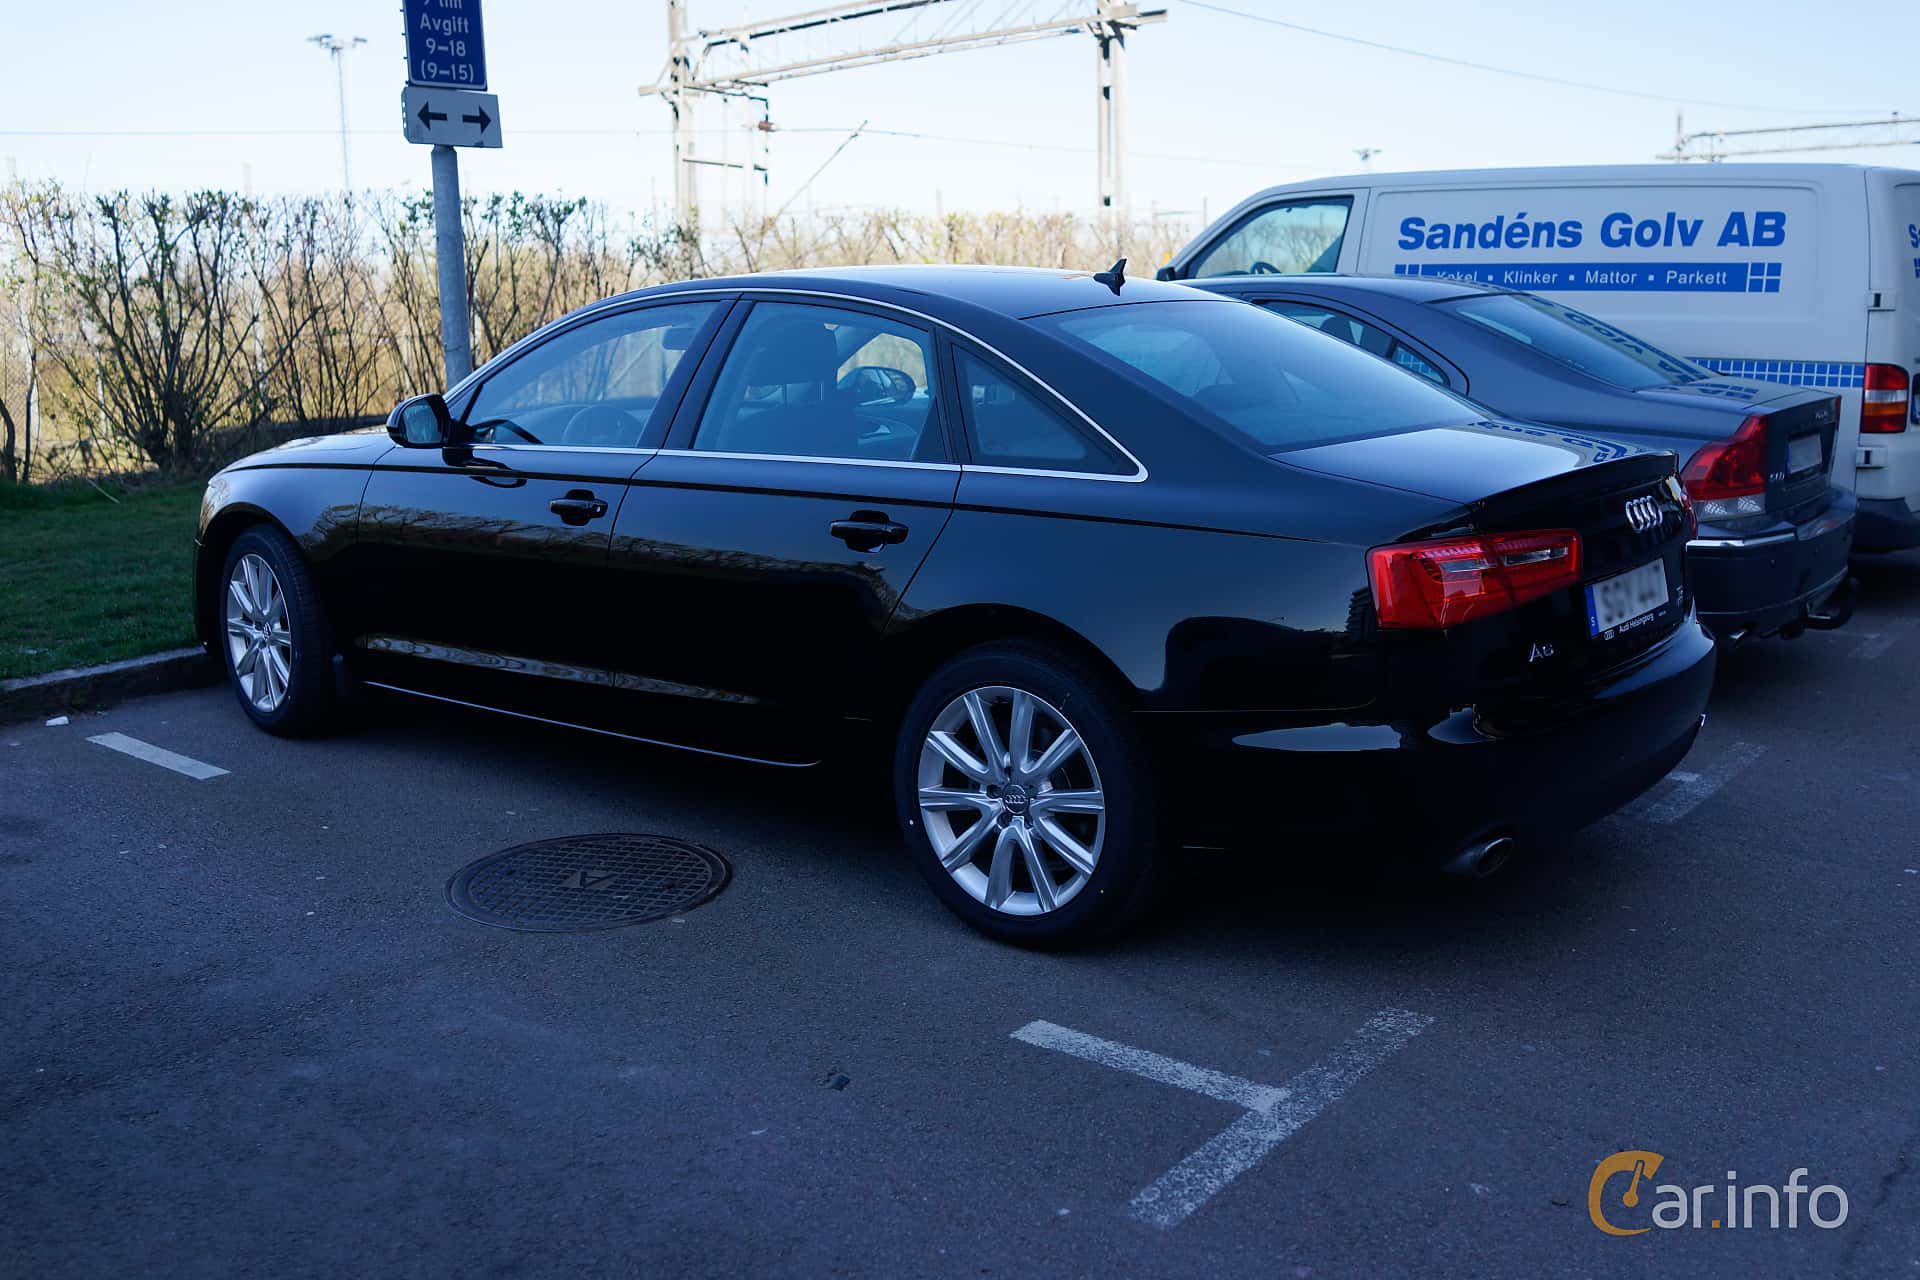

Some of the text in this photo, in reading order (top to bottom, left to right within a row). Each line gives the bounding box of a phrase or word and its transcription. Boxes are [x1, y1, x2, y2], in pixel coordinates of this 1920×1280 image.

[420, 13, 469, 36] Avgift
[1398, 211, 1786, 250] Sandéns Golv AB
[1503, 270, 1558, 285] Klinker
[1585, 270, 1637, 285] Mattor
[1666, 270, 1727, 285] Parkett
